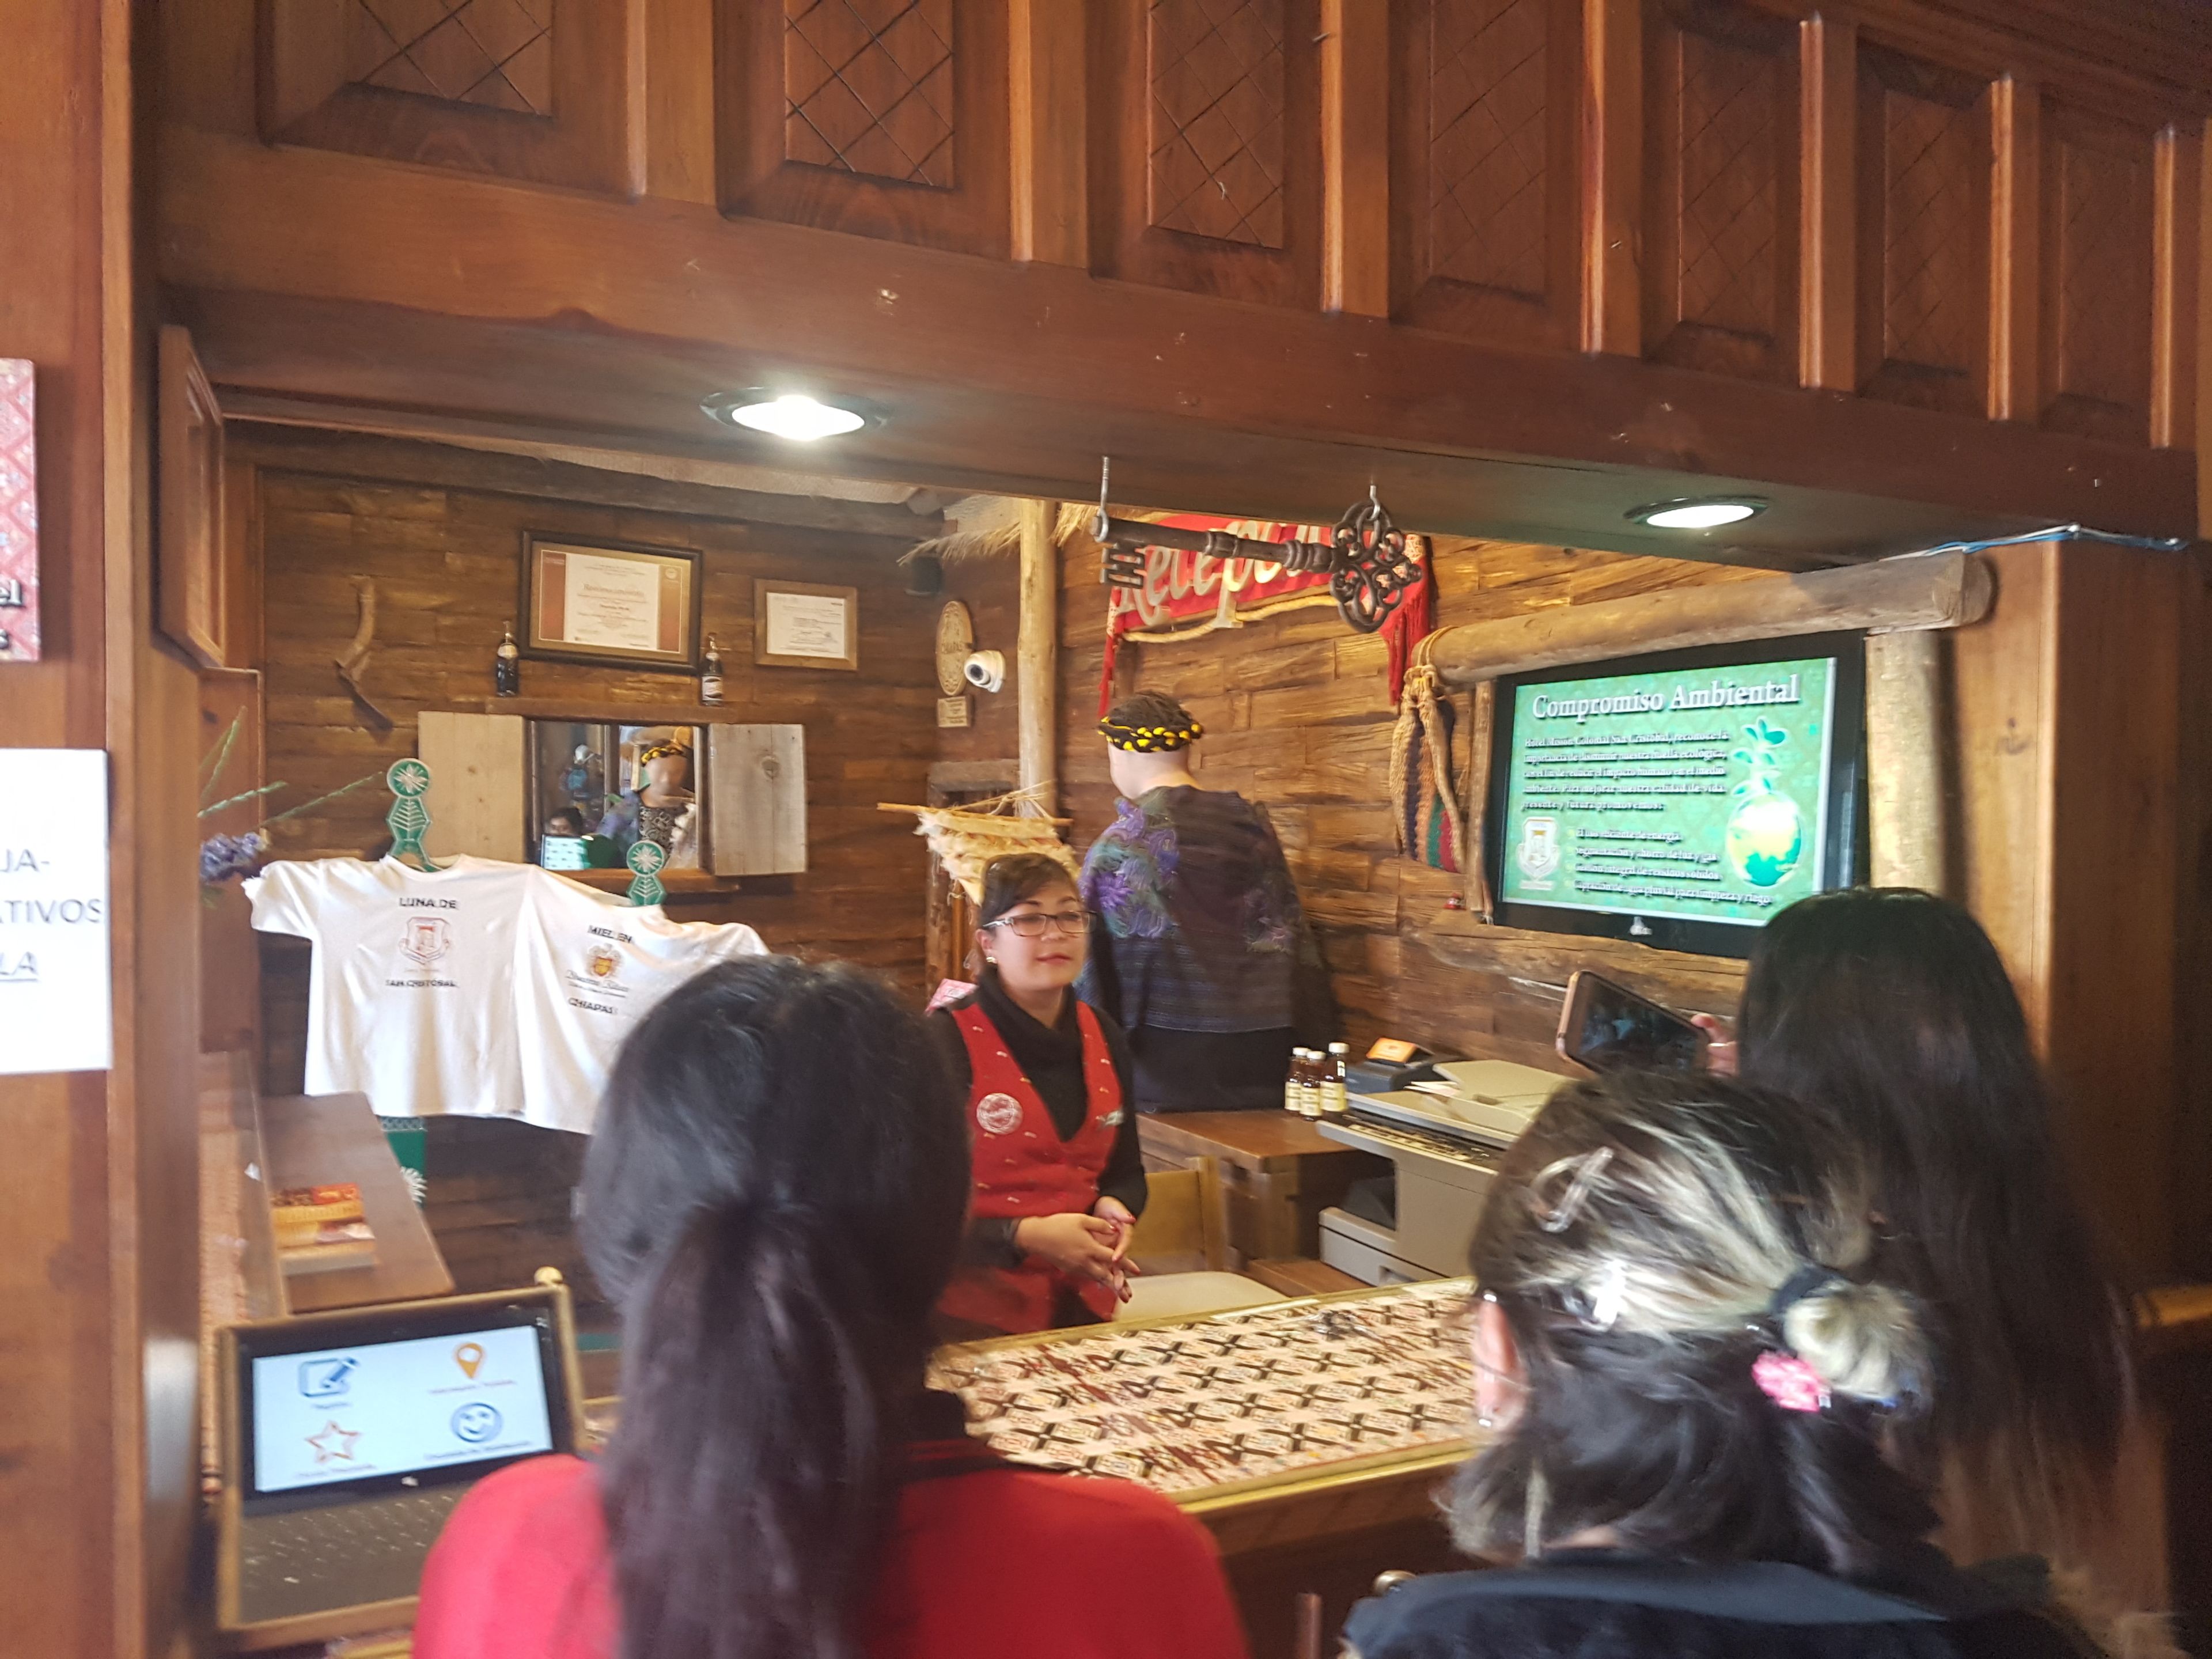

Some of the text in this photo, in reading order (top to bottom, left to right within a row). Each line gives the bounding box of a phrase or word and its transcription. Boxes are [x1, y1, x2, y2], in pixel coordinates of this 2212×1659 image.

[1533, 675, 1800, 724] Compromiso Ambiental
[0, 899, 101, 924] TIVOS
[399, 897, 459, 909] LUNA DE
